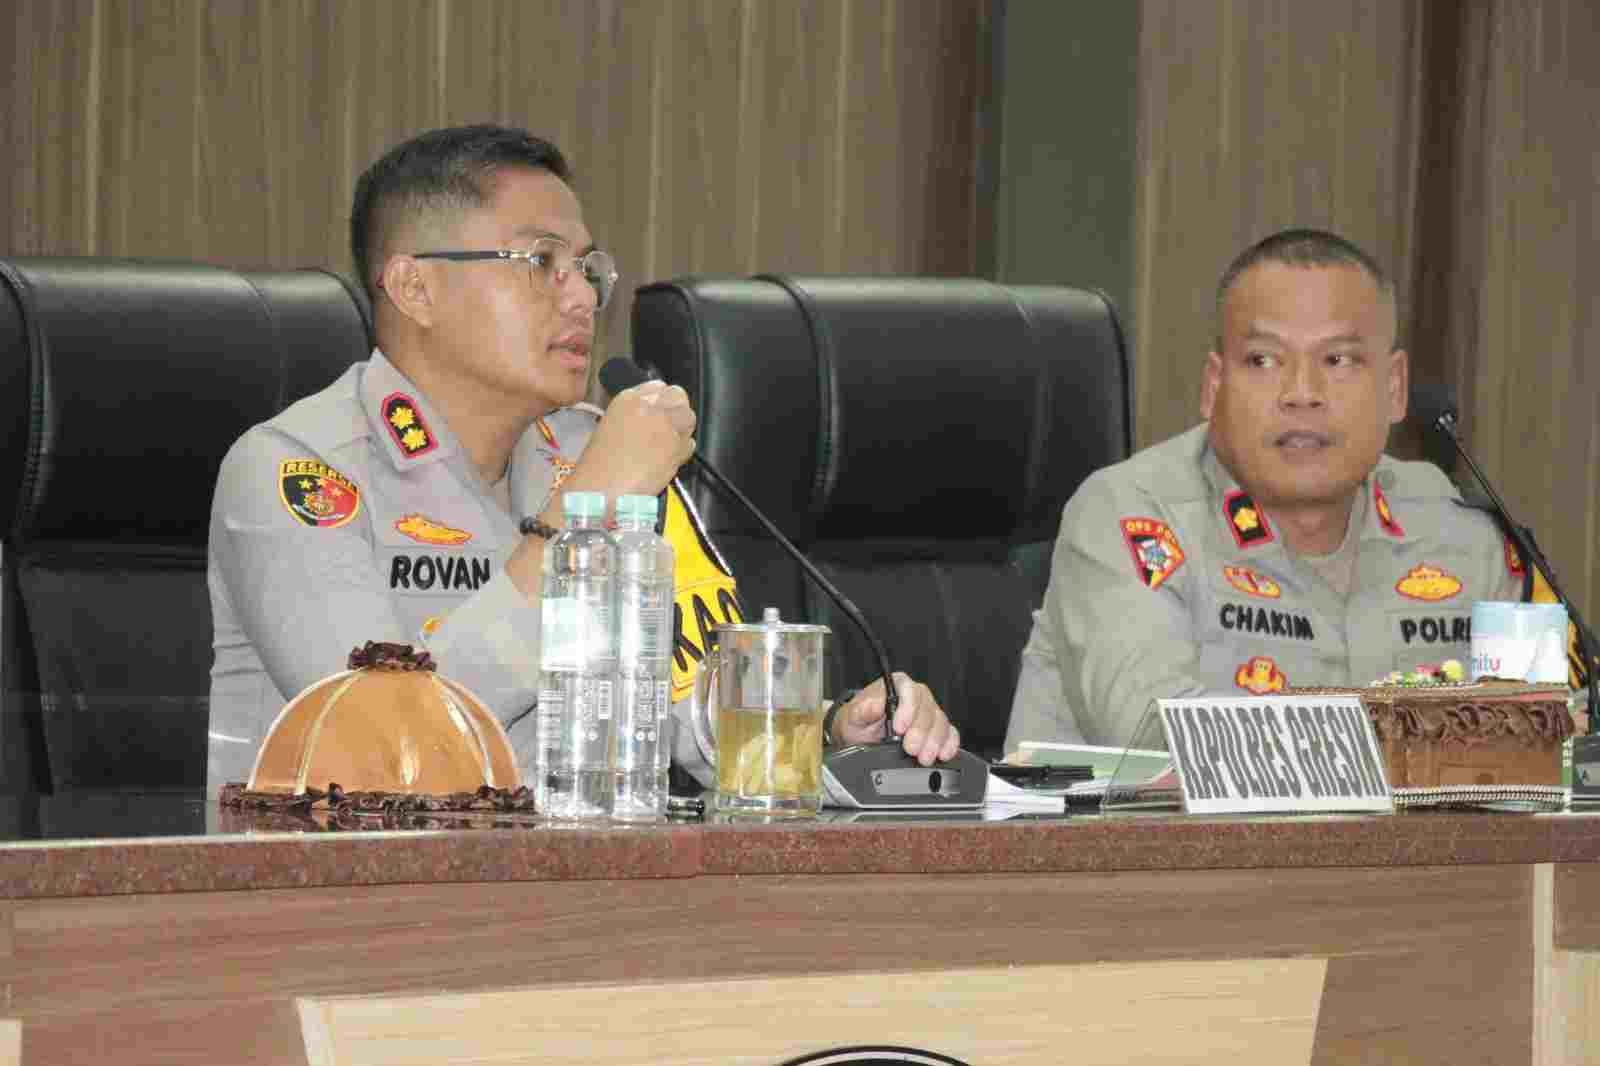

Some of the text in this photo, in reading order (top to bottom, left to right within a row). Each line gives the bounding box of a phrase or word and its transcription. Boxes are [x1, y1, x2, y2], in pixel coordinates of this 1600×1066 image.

[390, 555, 490, 590] ROVAN
[1219, 602, 1314, 640] CHAKIM
[1400, 615, 1472, 644] POLRI
[1165, 704, 1388, 800] KAPOLRES GRESIK
